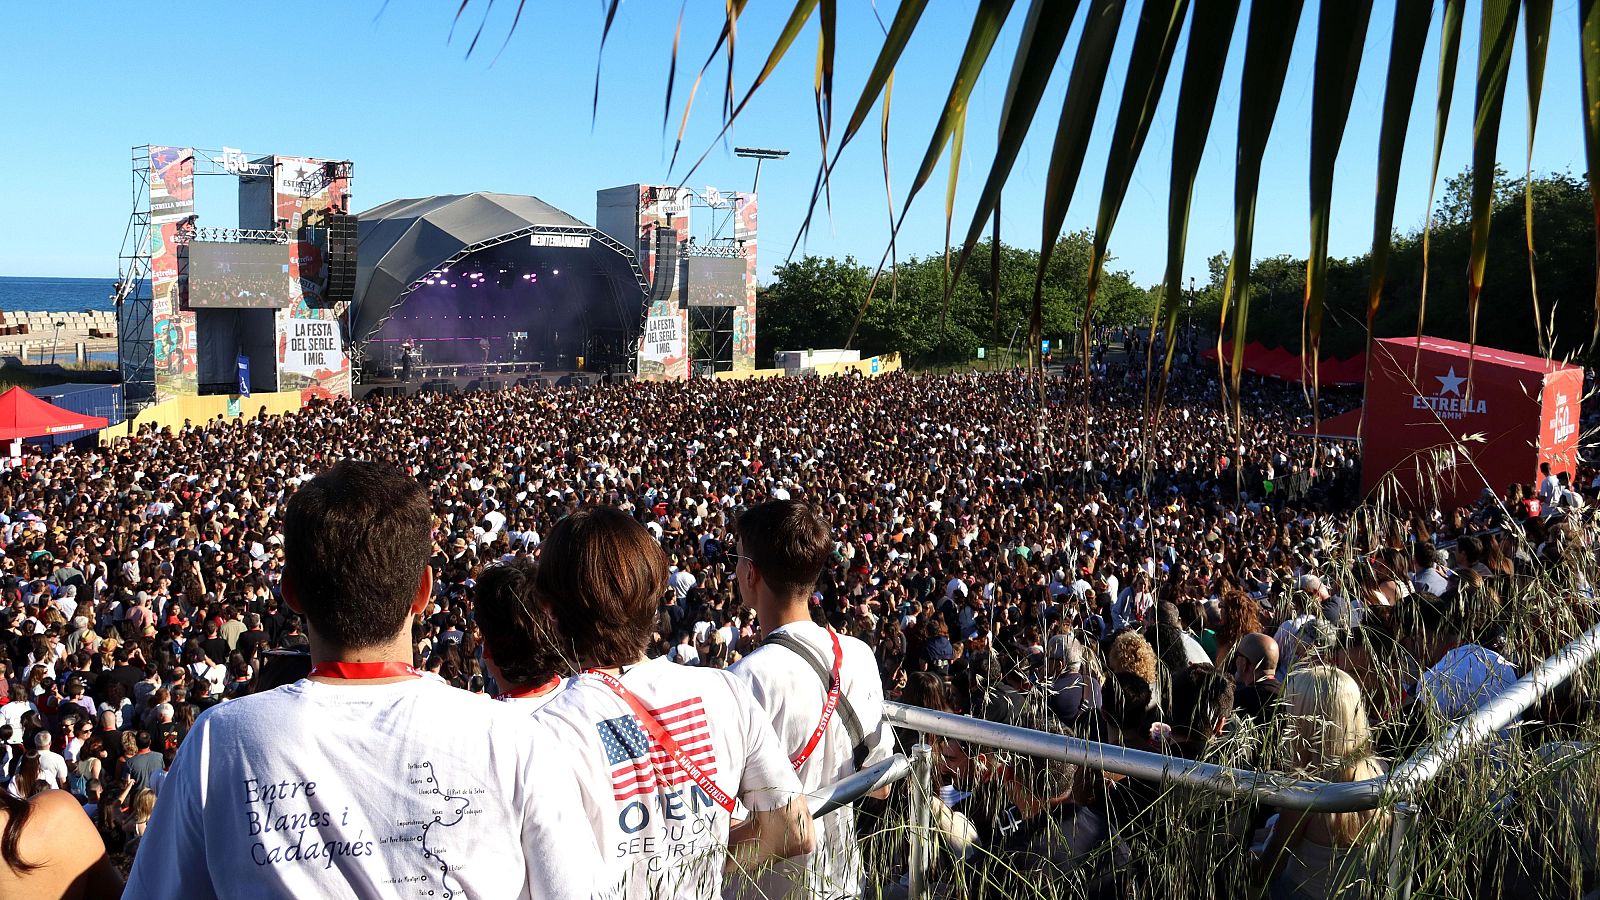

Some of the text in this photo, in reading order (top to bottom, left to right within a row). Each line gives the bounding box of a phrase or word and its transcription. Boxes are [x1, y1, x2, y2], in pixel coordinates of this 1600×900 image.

[295, 323, 333, 337] LA FESTA
[649, 318, 675, 331] LA FESTA
[291, 337, 337, 351] DEL SEGLE.
[647, 330, 678, 344] DEL SEGLE.
[659, 342, 672, 353] MIG.
[308, 352, 326, 366] MIG.
[1412, 395, 1487, 414] ESTRELLA
[592, 671, 620, 688] DAMM
[819, 695, 837, 732] ESTRELLA
[679, 755, 727, 804] ESTRELLA DAMM
[244, 779, 316, 804] Entre
[246, 800, 349, 836] Blanes i
[251, 829, 373, 869] Cadaqués
[616, 836, 656, 858] SEE
